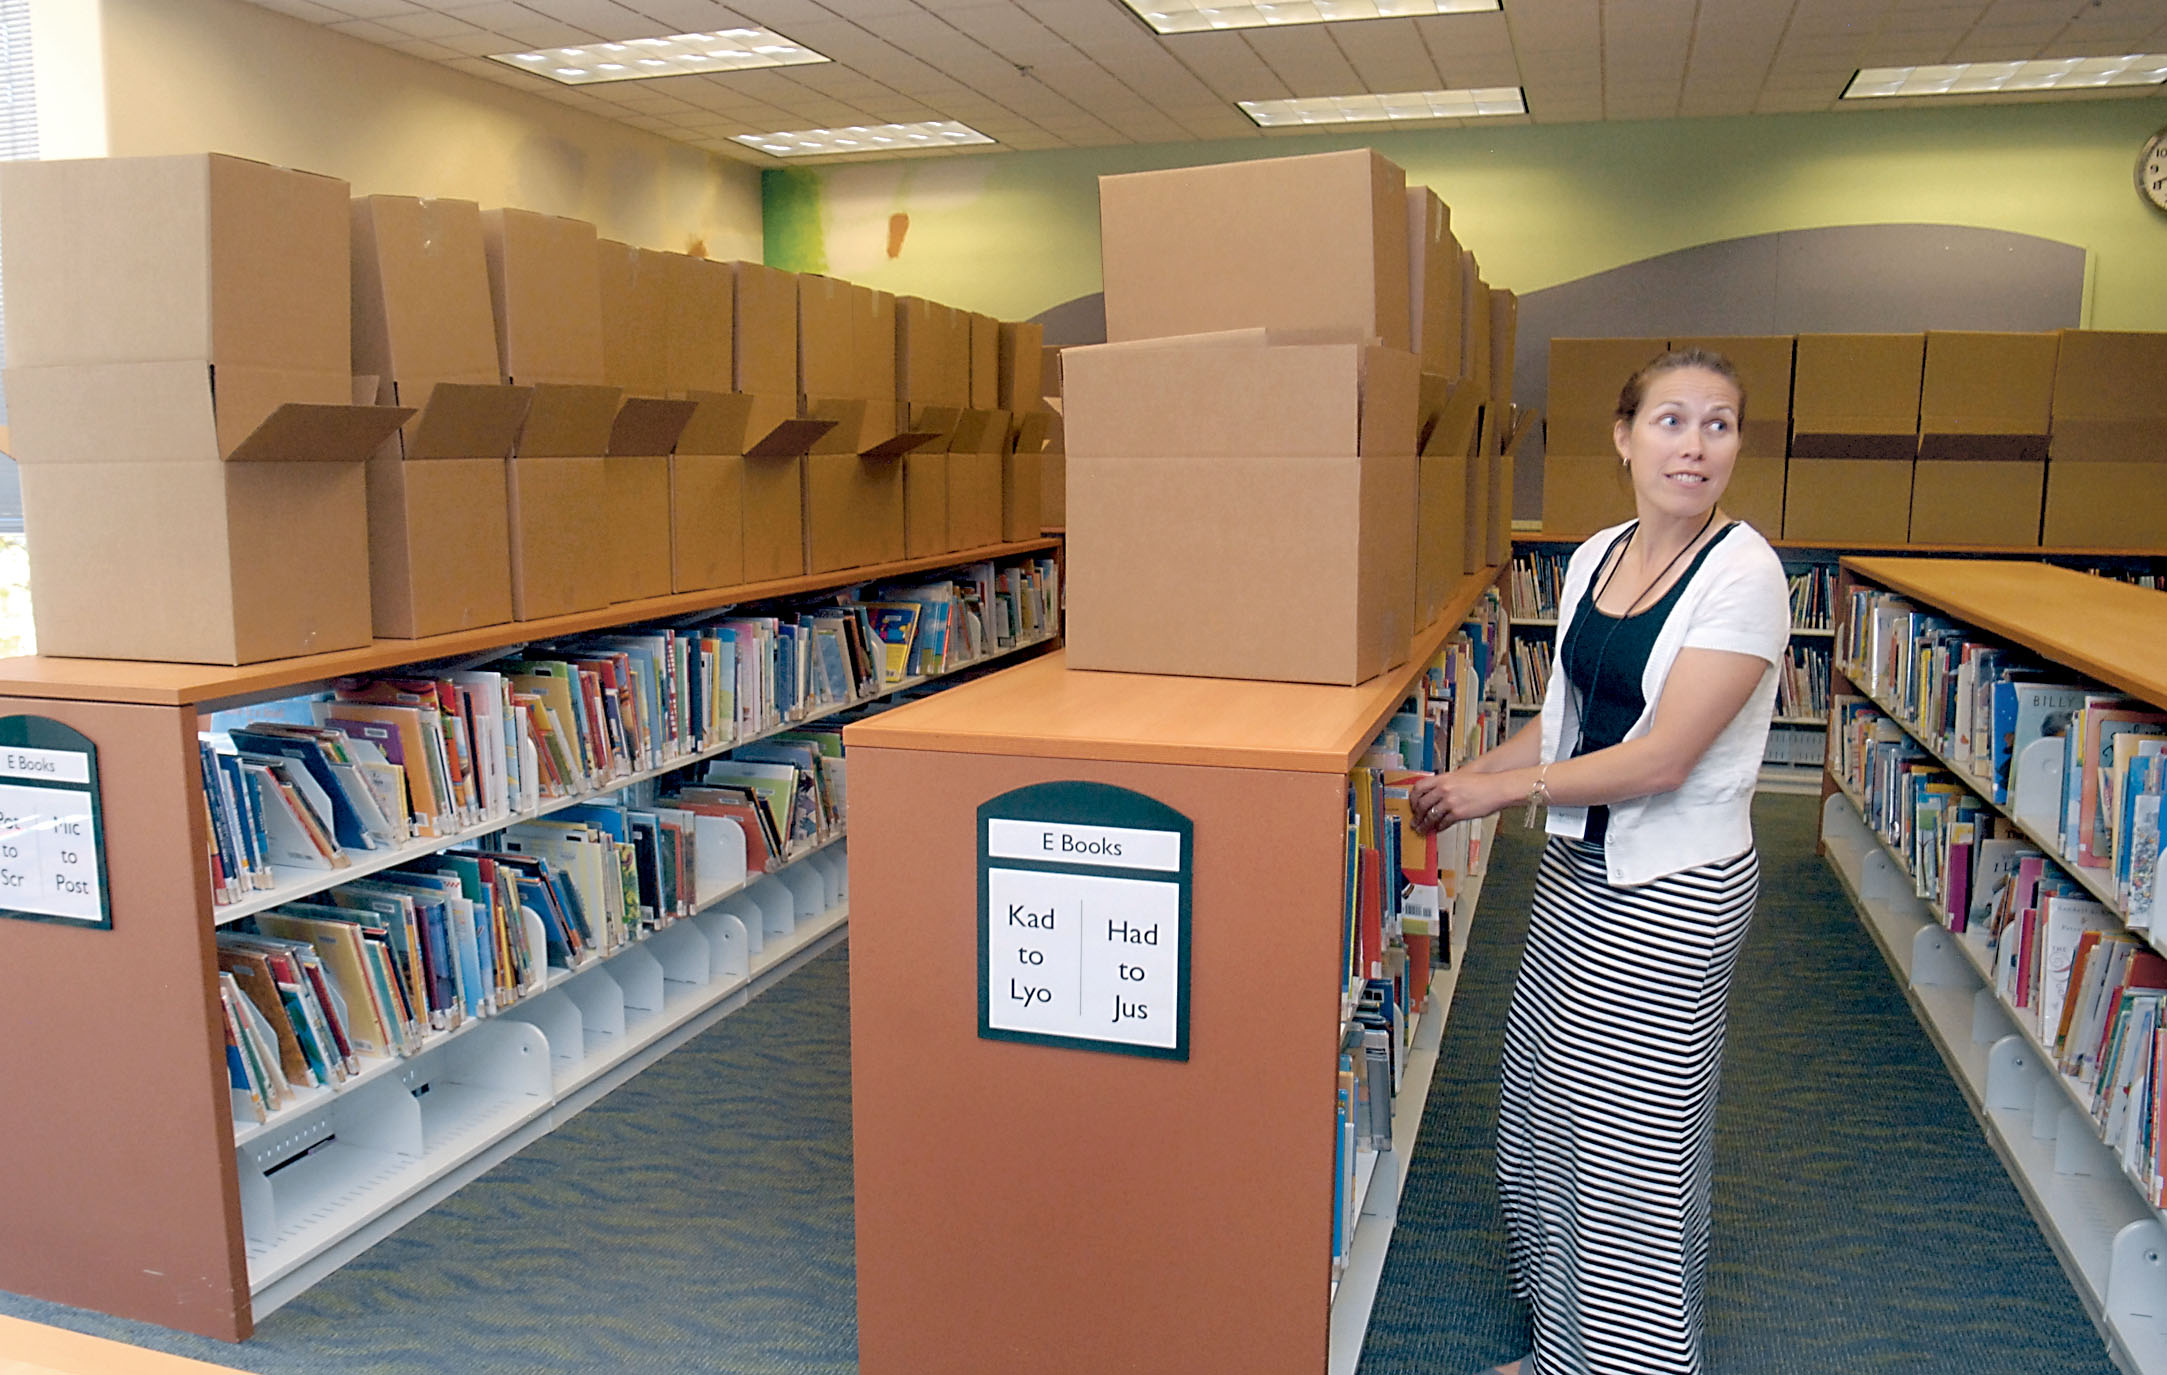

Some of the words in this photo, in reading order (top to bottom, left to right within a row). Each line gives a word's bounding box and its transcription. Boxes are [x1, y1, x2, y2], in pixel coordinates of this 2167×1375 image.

[2156, 148, 2167, 158] 10
[2150, 163, 2159, 174] 9
[2033, 695, 2076, 708] BILLY
[7, 754, 15, 769] E
[18, 755, 55, 773] Books
[2, 845, 18, 858] to
[1043, 832, 1054, 851] E
[1062, 833, 1122, 856] Books
[61, 850, 78, 865] to
[1, 868, 25, 887] Scr
[56, 873, 89, 895] Post
[1009, 904, 1055, 930] Kad
[1108, 919, 1158, 946] Had
[1018, 947, 1044, 966] to
[1119, 963, 1145, 982] to
[1011, 977, 1052, 1008] Lyo
[1111, 994, 1148, 1023] Jus
